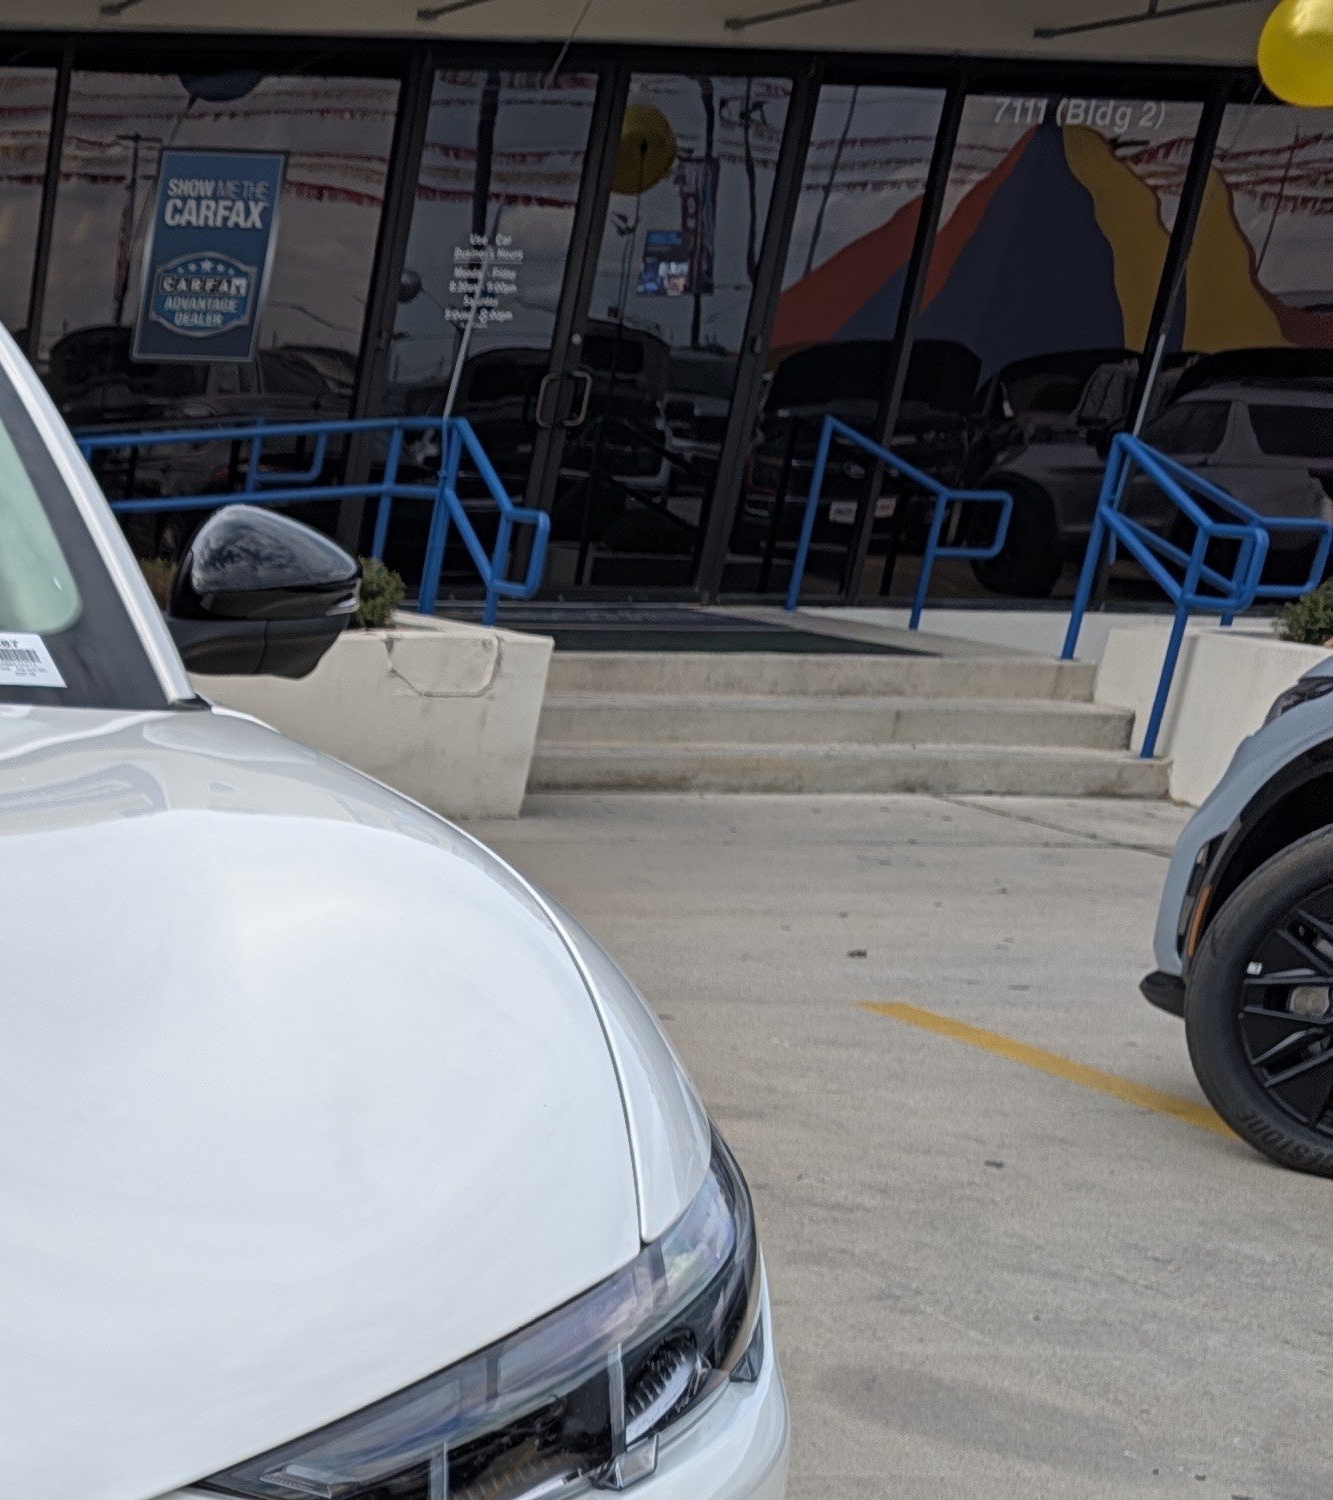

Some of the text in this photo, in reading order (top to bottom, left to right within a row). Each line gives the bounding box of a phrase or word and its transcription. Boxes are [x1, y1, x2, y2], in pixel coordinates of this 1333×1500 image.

[994, 97, 1166, 133] 7111 (Bldg 2)
[167, 178, 269, 200] SHOW ME THE
[164, 198, 267, 229] CARFAX
[161, 276, 247, 297] CARFAX
[163, 296, 238, 313] ADVANTAGE
[174, 311, 224, 327] DEALER
